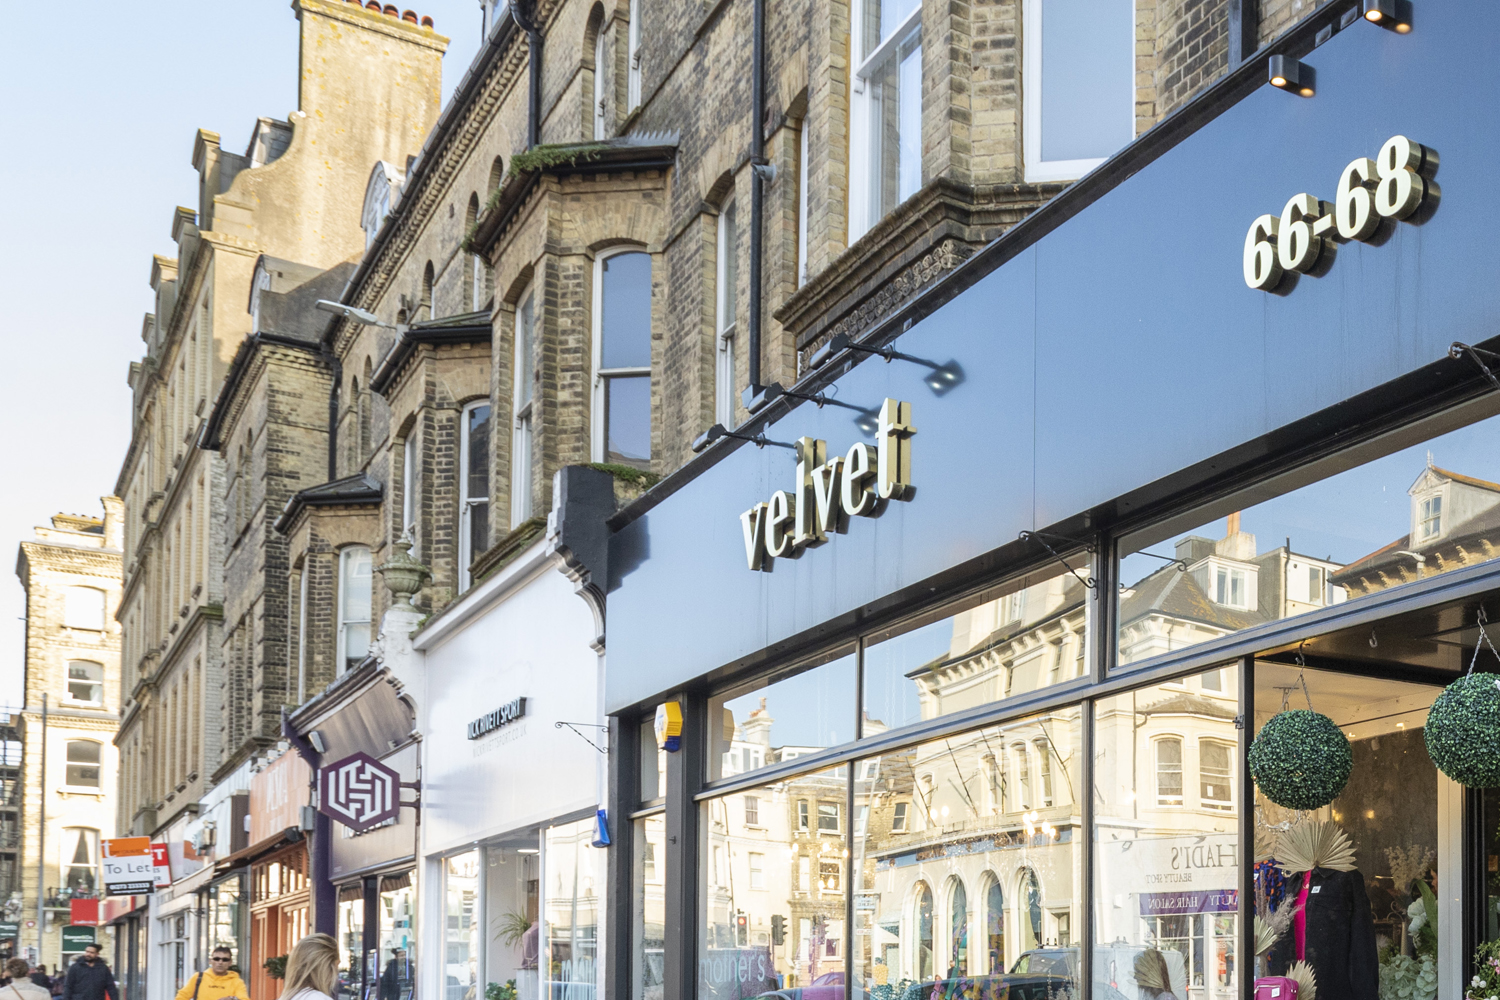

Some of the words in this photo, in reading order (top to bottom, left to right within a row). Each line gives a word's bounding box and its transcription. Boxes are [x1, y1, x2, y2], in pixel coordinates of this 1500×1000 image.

[1243, 134, 1425, 291] 66-68
[739, 397, 914, 571] velvet
[480, 707, 501, 734] RIVETT
[500, 696, 527, 724] SPORT
[104, 863, 123, 875] To
[127, 862, 151, 874] Let
[698, 953, 766, 983] mother's
